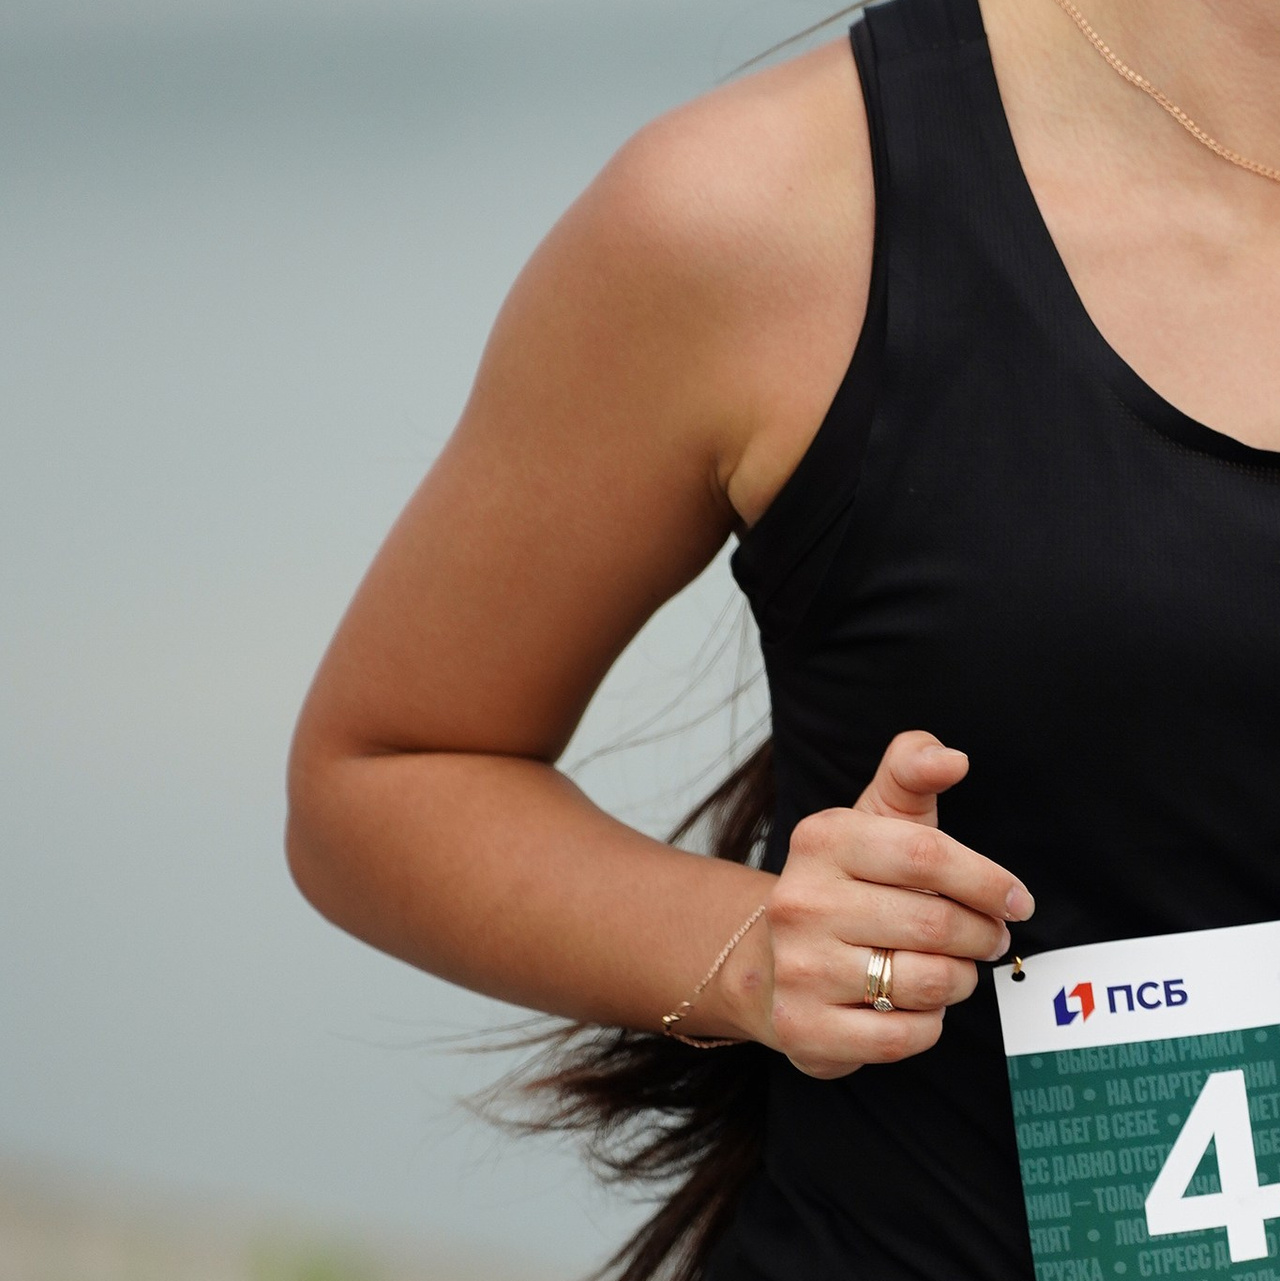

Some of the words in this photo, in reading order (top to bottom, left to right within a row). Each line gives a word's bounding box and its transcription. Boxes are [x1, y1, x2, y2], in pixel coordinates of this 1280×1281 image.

[1107, 978, 1188, 1014] ПСБ
[1059, 1116, 1092, 1145] БЕГ
[1095, 1114, 1110, 1141] В
[1111, 1108, 1160, 1139] СЕБЕ
[1052, 1150, 1117, 1186] ДАВНО
[1138, 1243, 1213, 1277] СТРЕСС
